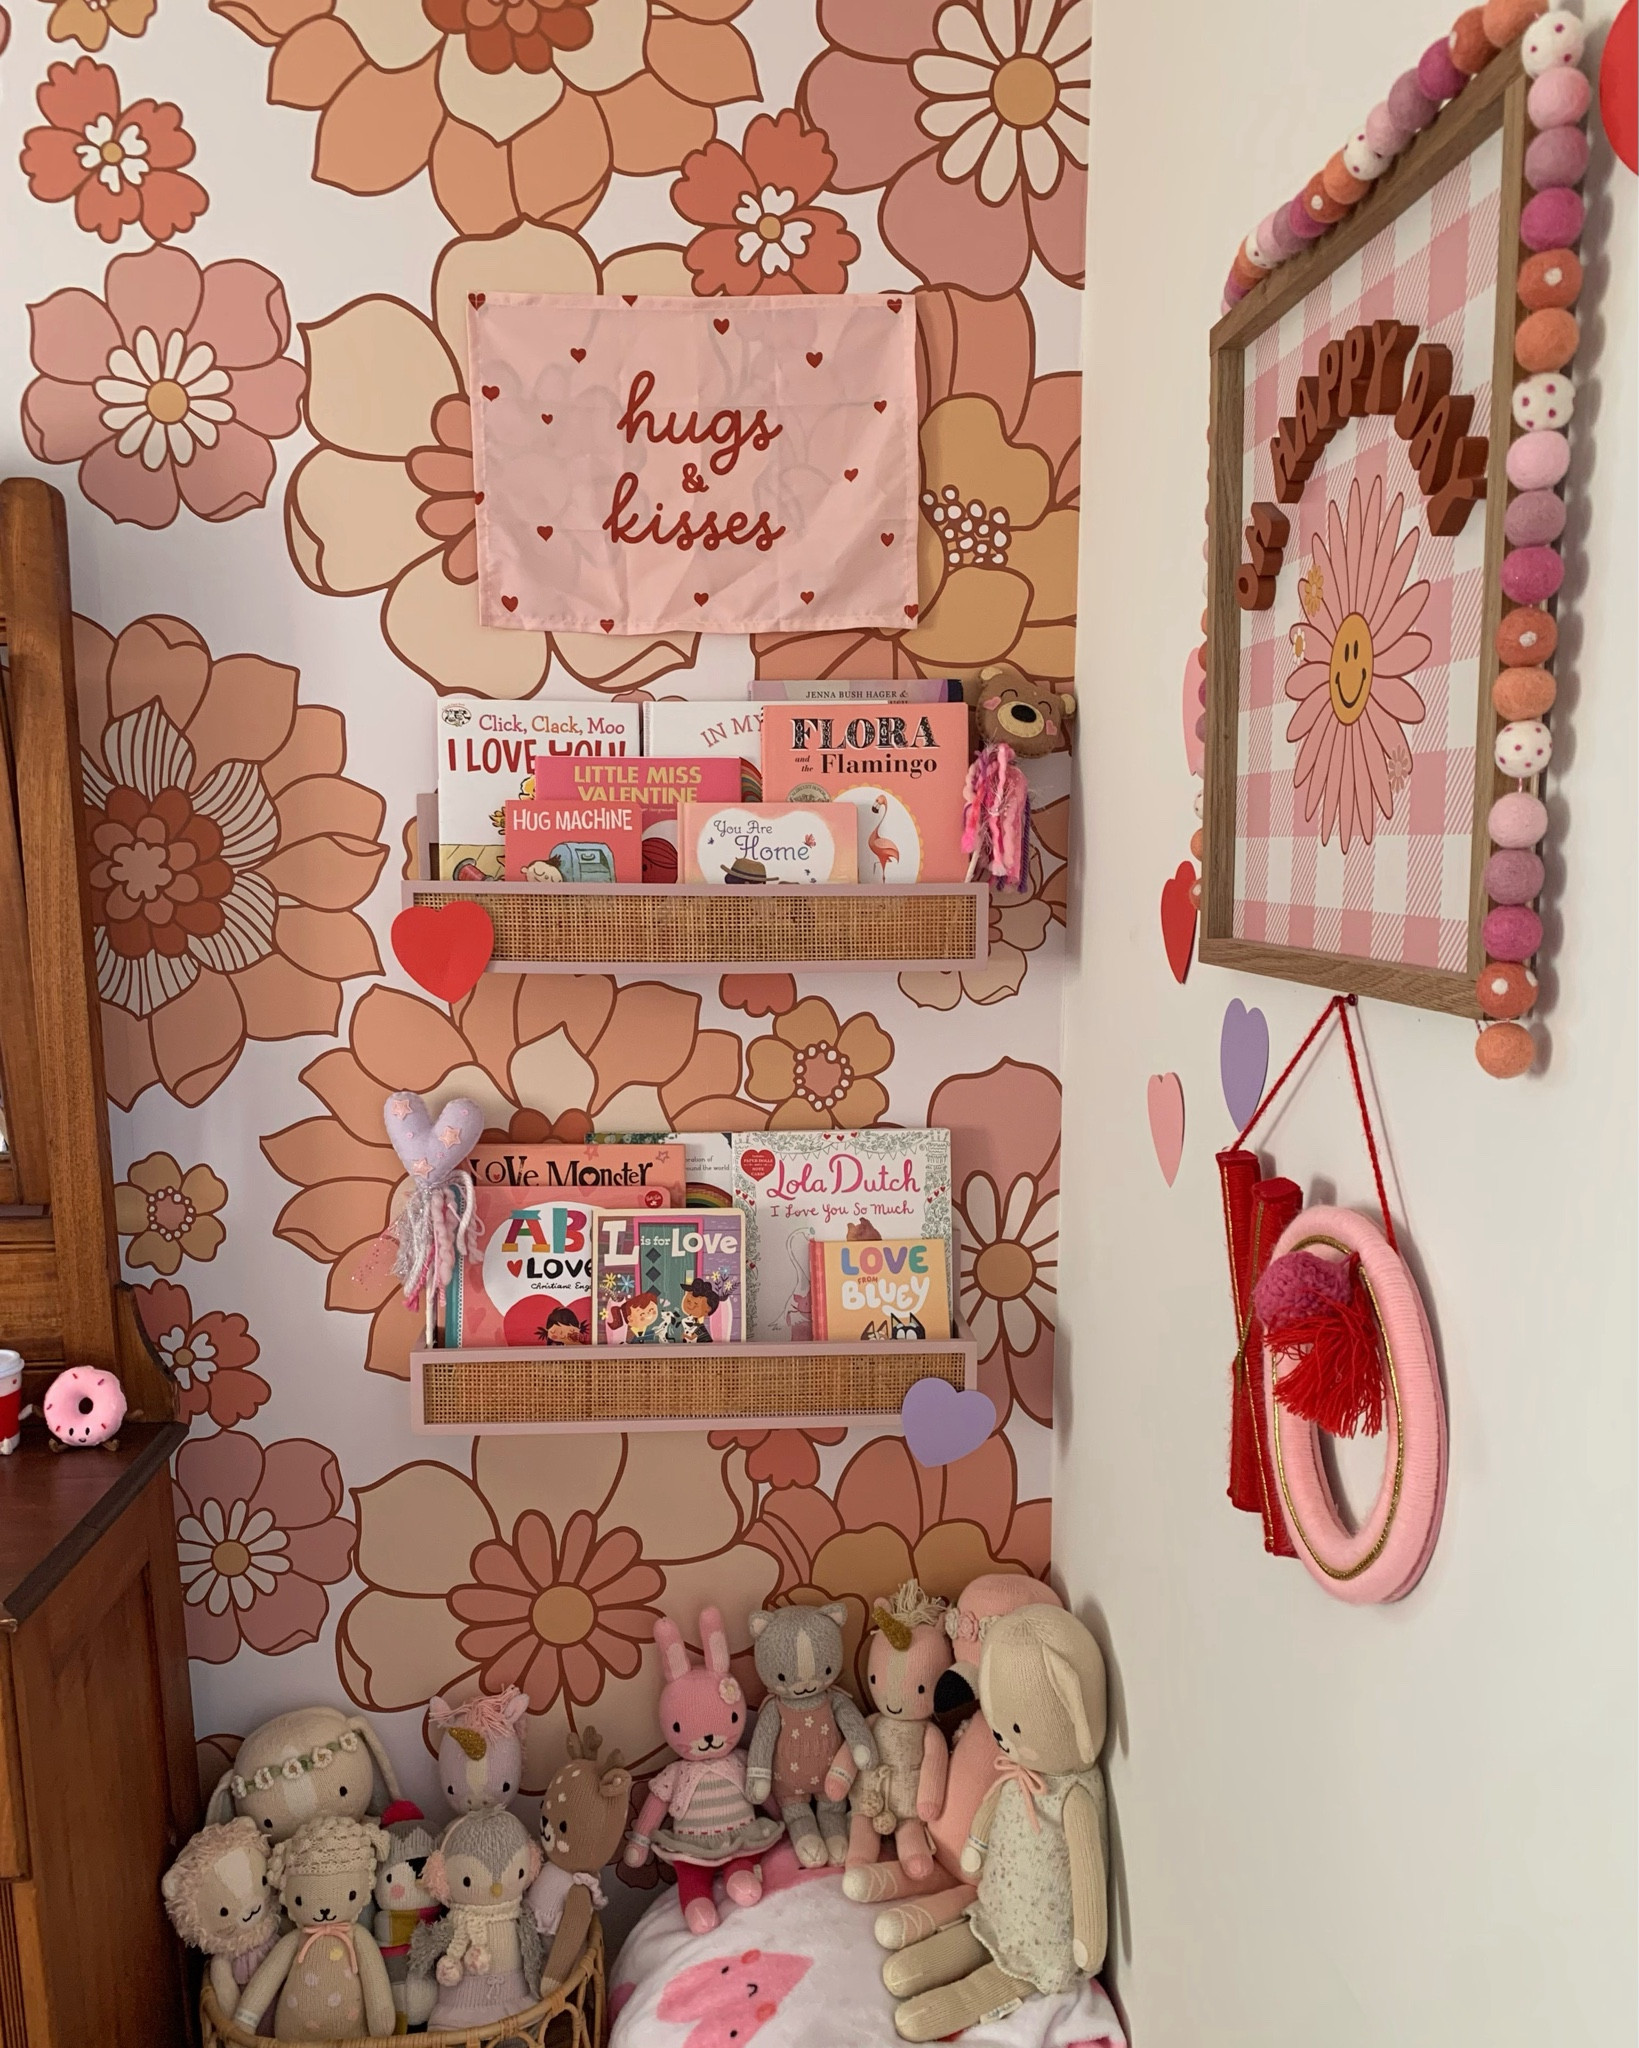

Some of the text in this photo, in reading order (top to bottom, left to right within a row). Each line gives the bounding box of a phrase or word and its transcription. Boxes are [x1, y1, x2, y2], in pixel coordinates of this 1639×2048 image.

[617, 370, 783, 475] hugs
[682, 462, 710, 493] &
[1236, 320, 1489, 611] OH HAPPY DAY
[602, 472, 786, 551] kisses
[806, 690, 909, 699] JENNA BUSH HAGER &
[479, 714, 625, 735] Click, Clack, Moo
[700, 722, 728, 748] IN
[789, 716, 940, 751] FLORA
[448, 738, 457, 771] I
[466, 738, 537, 774] LOVE
[795, 755, 810, 763] and
[801, 764, 813, 772] the
[821, 753, 937, 779] Flamingo
[574, 766, 702, 784] LITTLE MISS
[577, 786, 698, 805] VALENTINE
[513, 808, 551, 831] HUG
[713, 820, 773, 837] You Are
[735, 835, 810, 861] Home
[766, 1153, 921, 1201] Lola Dutch
[770, 1200, 915, 1223] I Love You So Much
[501, 1208, 592, 1254] AB
[602, 1220, 640, 1266] L
[640, 1236, 651, 1246] is
[653, 1236, 670, 1246] for
[841, 1245, 929, 1276] LOVE
[531, 1282, 571, 1290] Christiane
[857, 1276, 878, 1284] FROM
[841, 1275, 930, 1318] BLUEY
